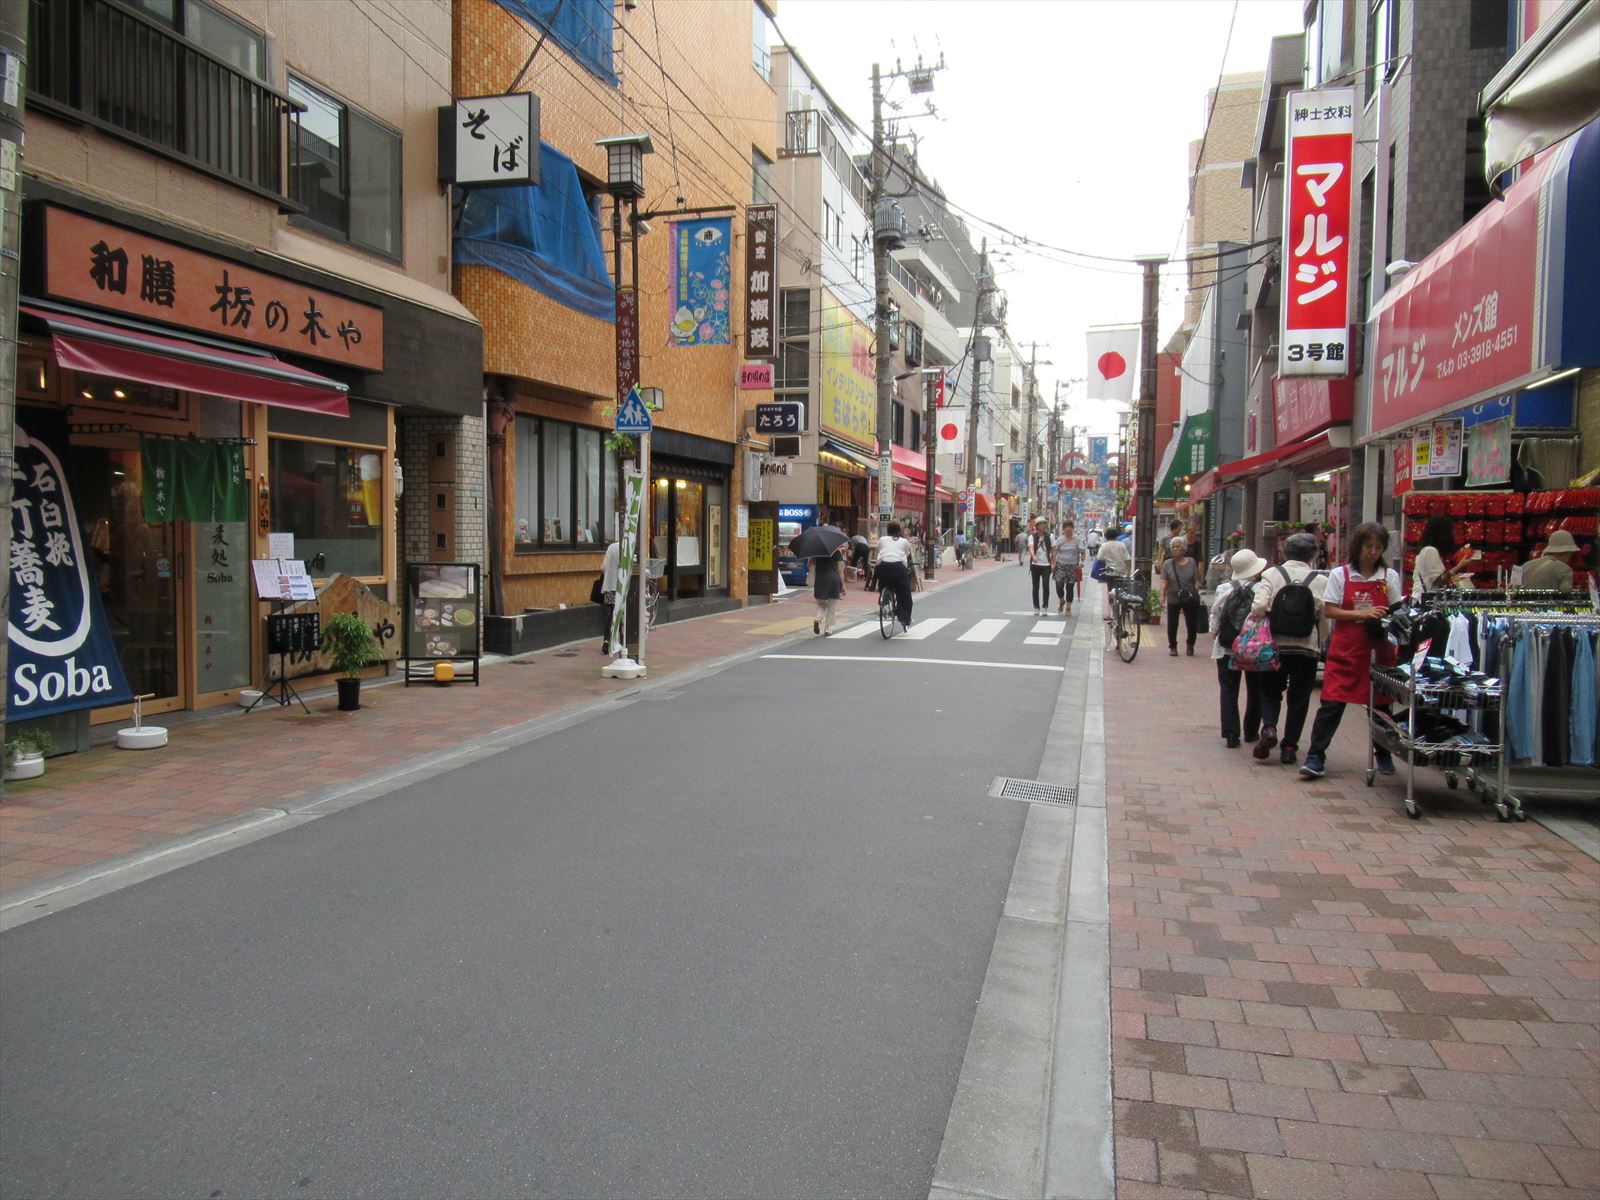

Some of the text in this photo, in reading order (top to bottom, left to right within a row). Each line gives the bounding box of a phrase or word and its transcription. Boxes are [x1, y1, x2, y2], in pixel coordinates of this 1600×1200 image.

[1294, 104, 1352, 122] 紳士衣料
[462, 108, 523, 174] そば
[1295, 162, 1344, 305] マルジ
[89, 240, 362, 351] 和膳 栃の木や
[1452, 290, 1499, 349] メンズ館
[1287, 342, 1345, 363] 3号館
[1382, 334, 1426, 404] マルジ
[759, 414, 796, 427] たろう
[30, 462, 74, 567] 石臼挽
[784, 508, 803, 517] BOSS
[207, 572, 233, 584] Soba
[14, 657, 113, 707] Soba
